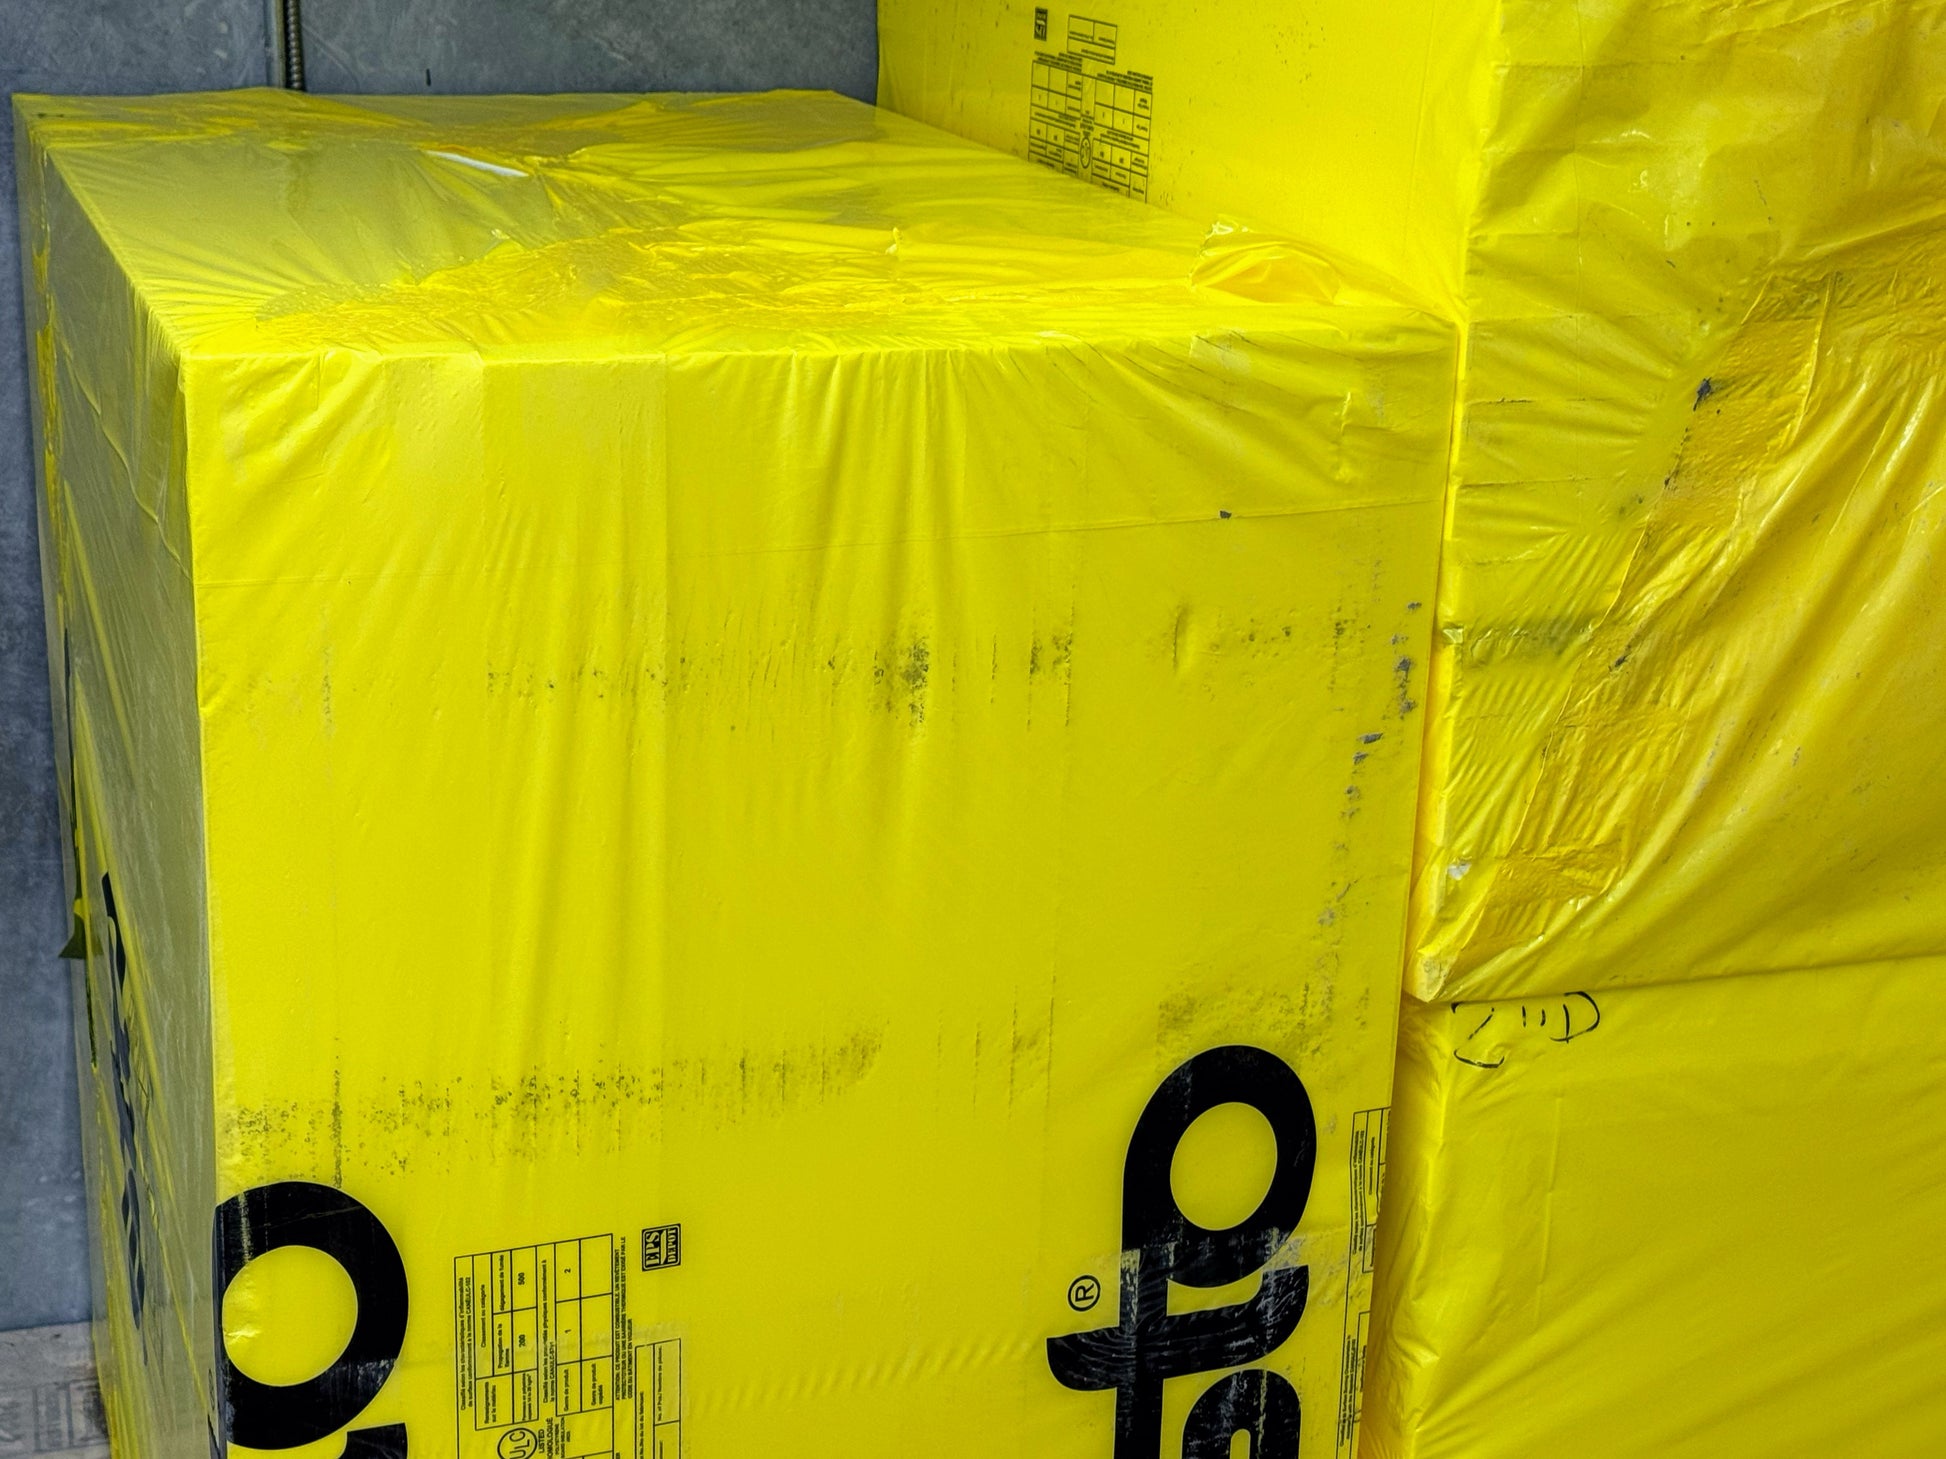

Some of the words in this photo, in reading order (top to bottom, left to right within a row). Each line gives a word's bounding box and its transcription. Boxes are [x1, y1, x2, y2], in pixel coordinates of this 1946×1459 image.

[645, 1231, 660, 1266] EPS
[666, 1228, 677, 1262] DEPOT
[517, 1272, 525, 1286] 500
[614, 1283, 620, 1291] UN
[518, 1334, 526, 1348] 200
[627, 1342, 633, 1350] EN
[508, 1431, 530, 1459] ULC
